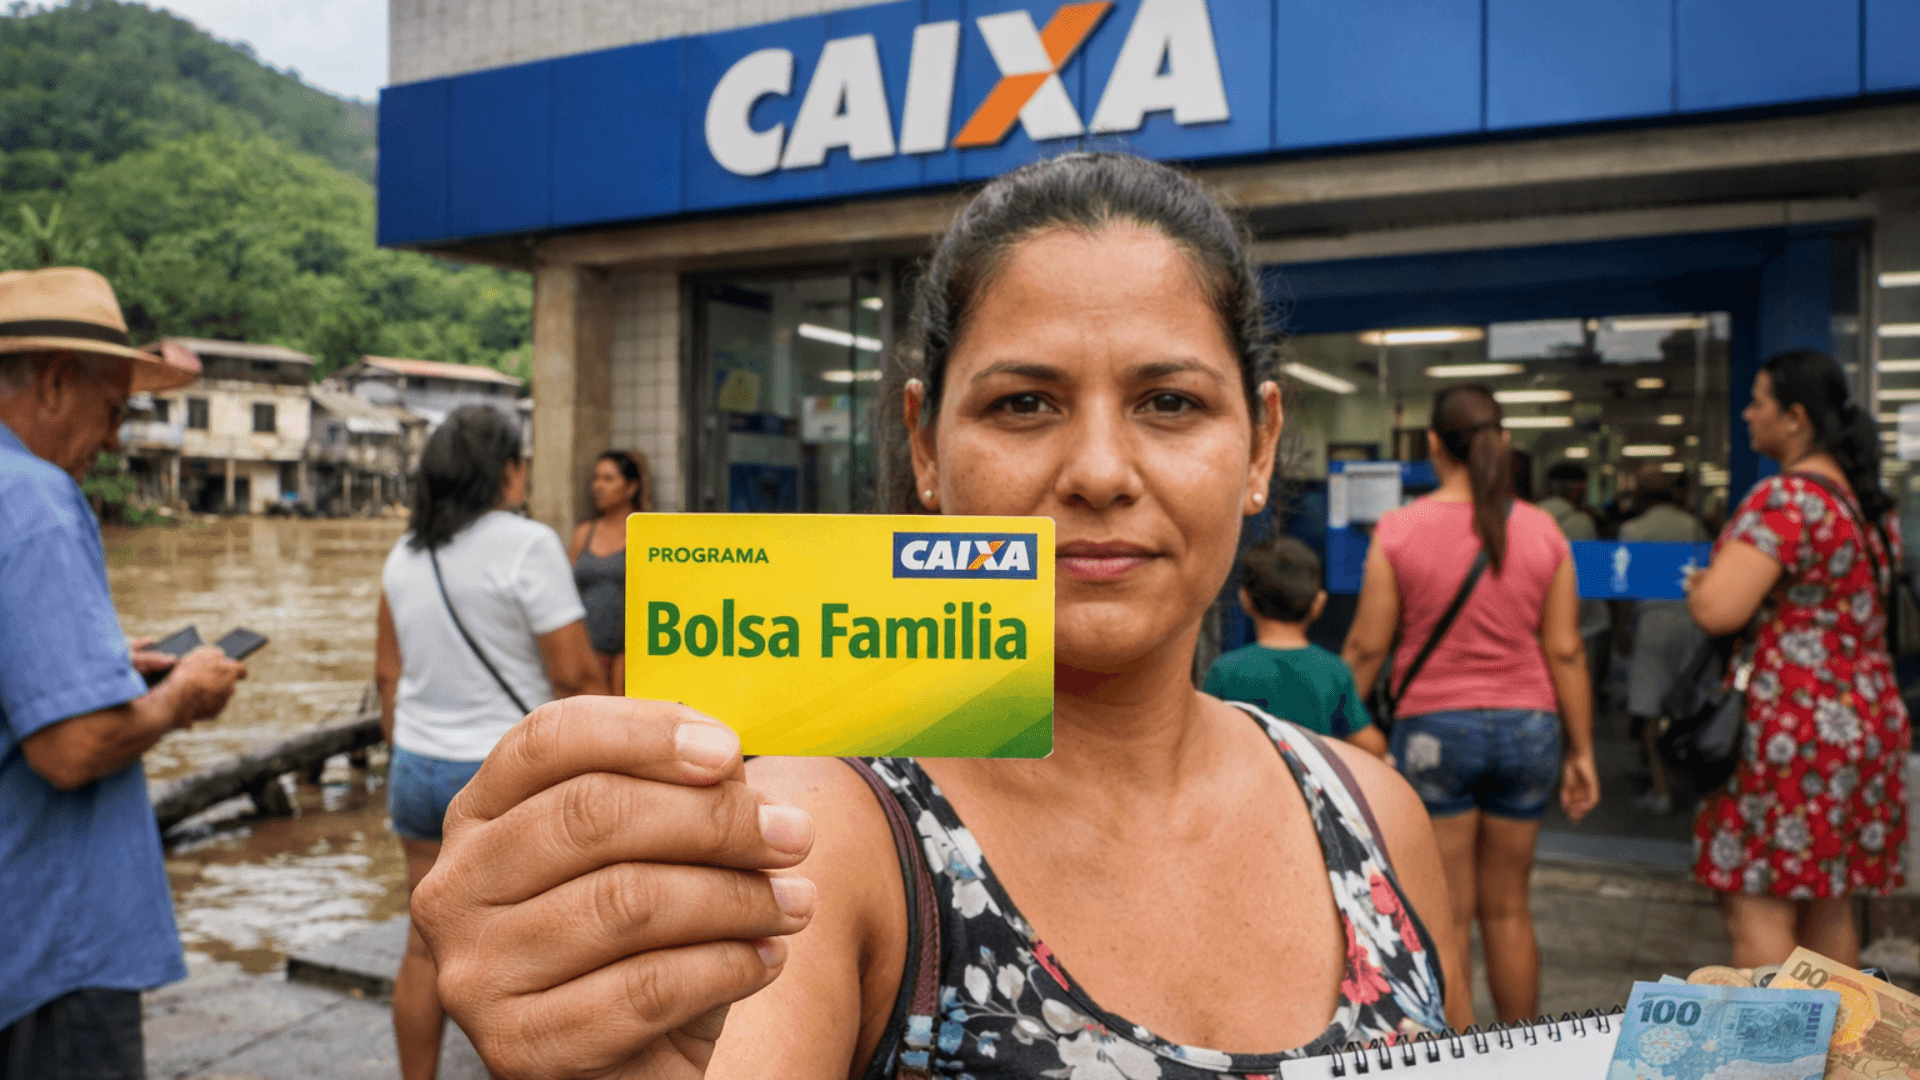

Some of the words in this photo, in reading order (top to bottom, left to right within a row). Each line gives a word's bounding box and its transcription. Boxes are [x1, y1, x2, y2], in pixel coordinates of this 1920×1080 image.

[705, 0, 1230, 176] CAIXA
[648, 547, 769, 564] PROGRAMA
[900, 540, 1031, 571] CAIXA
[647, 599, 800, 658] Bolsa
[821, 601, 1028, 660] Familia
[1637, 1000, 1702, 1027] 100
